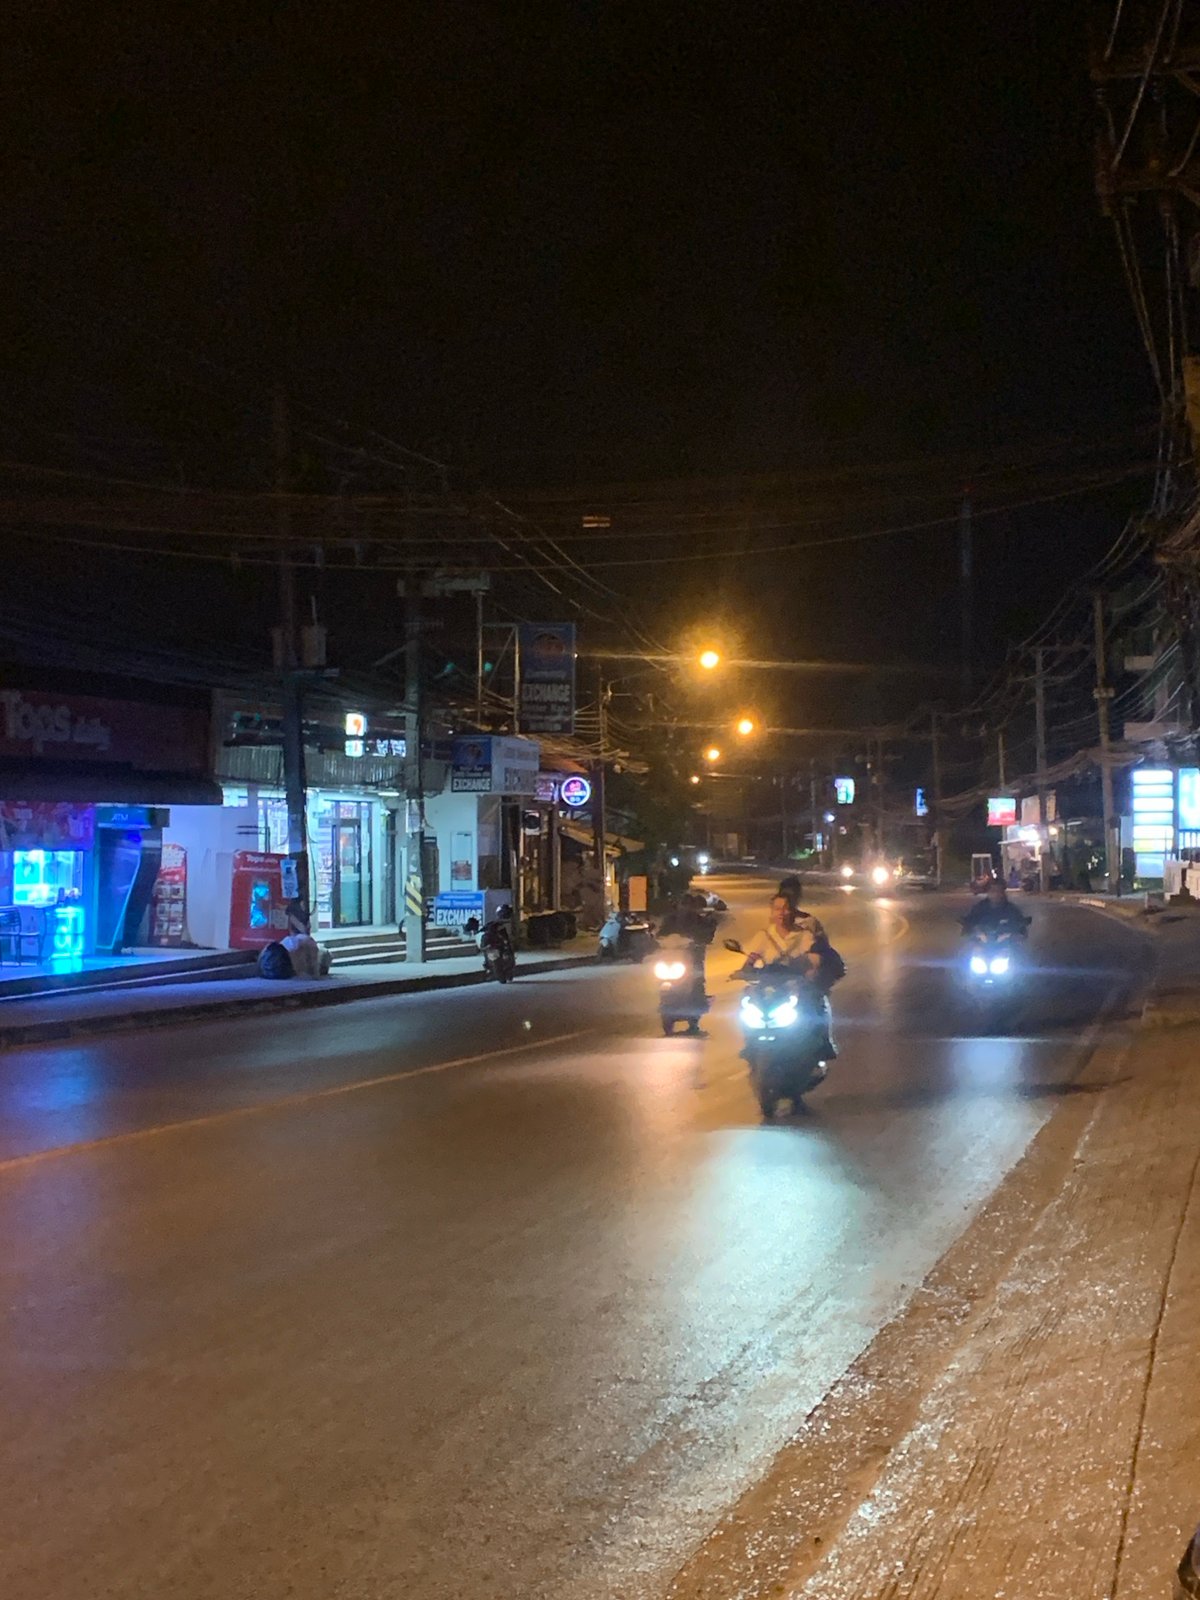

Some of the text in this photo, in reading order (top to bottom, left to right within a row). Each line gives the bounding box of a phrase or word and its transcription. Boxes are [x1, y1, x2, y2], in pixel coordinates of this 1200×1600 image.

[522, 684, 571, 702] EXCHANGE
[453, 778, 491, 791] EXCHANGE
[111, 814, 129, 822] ATM
